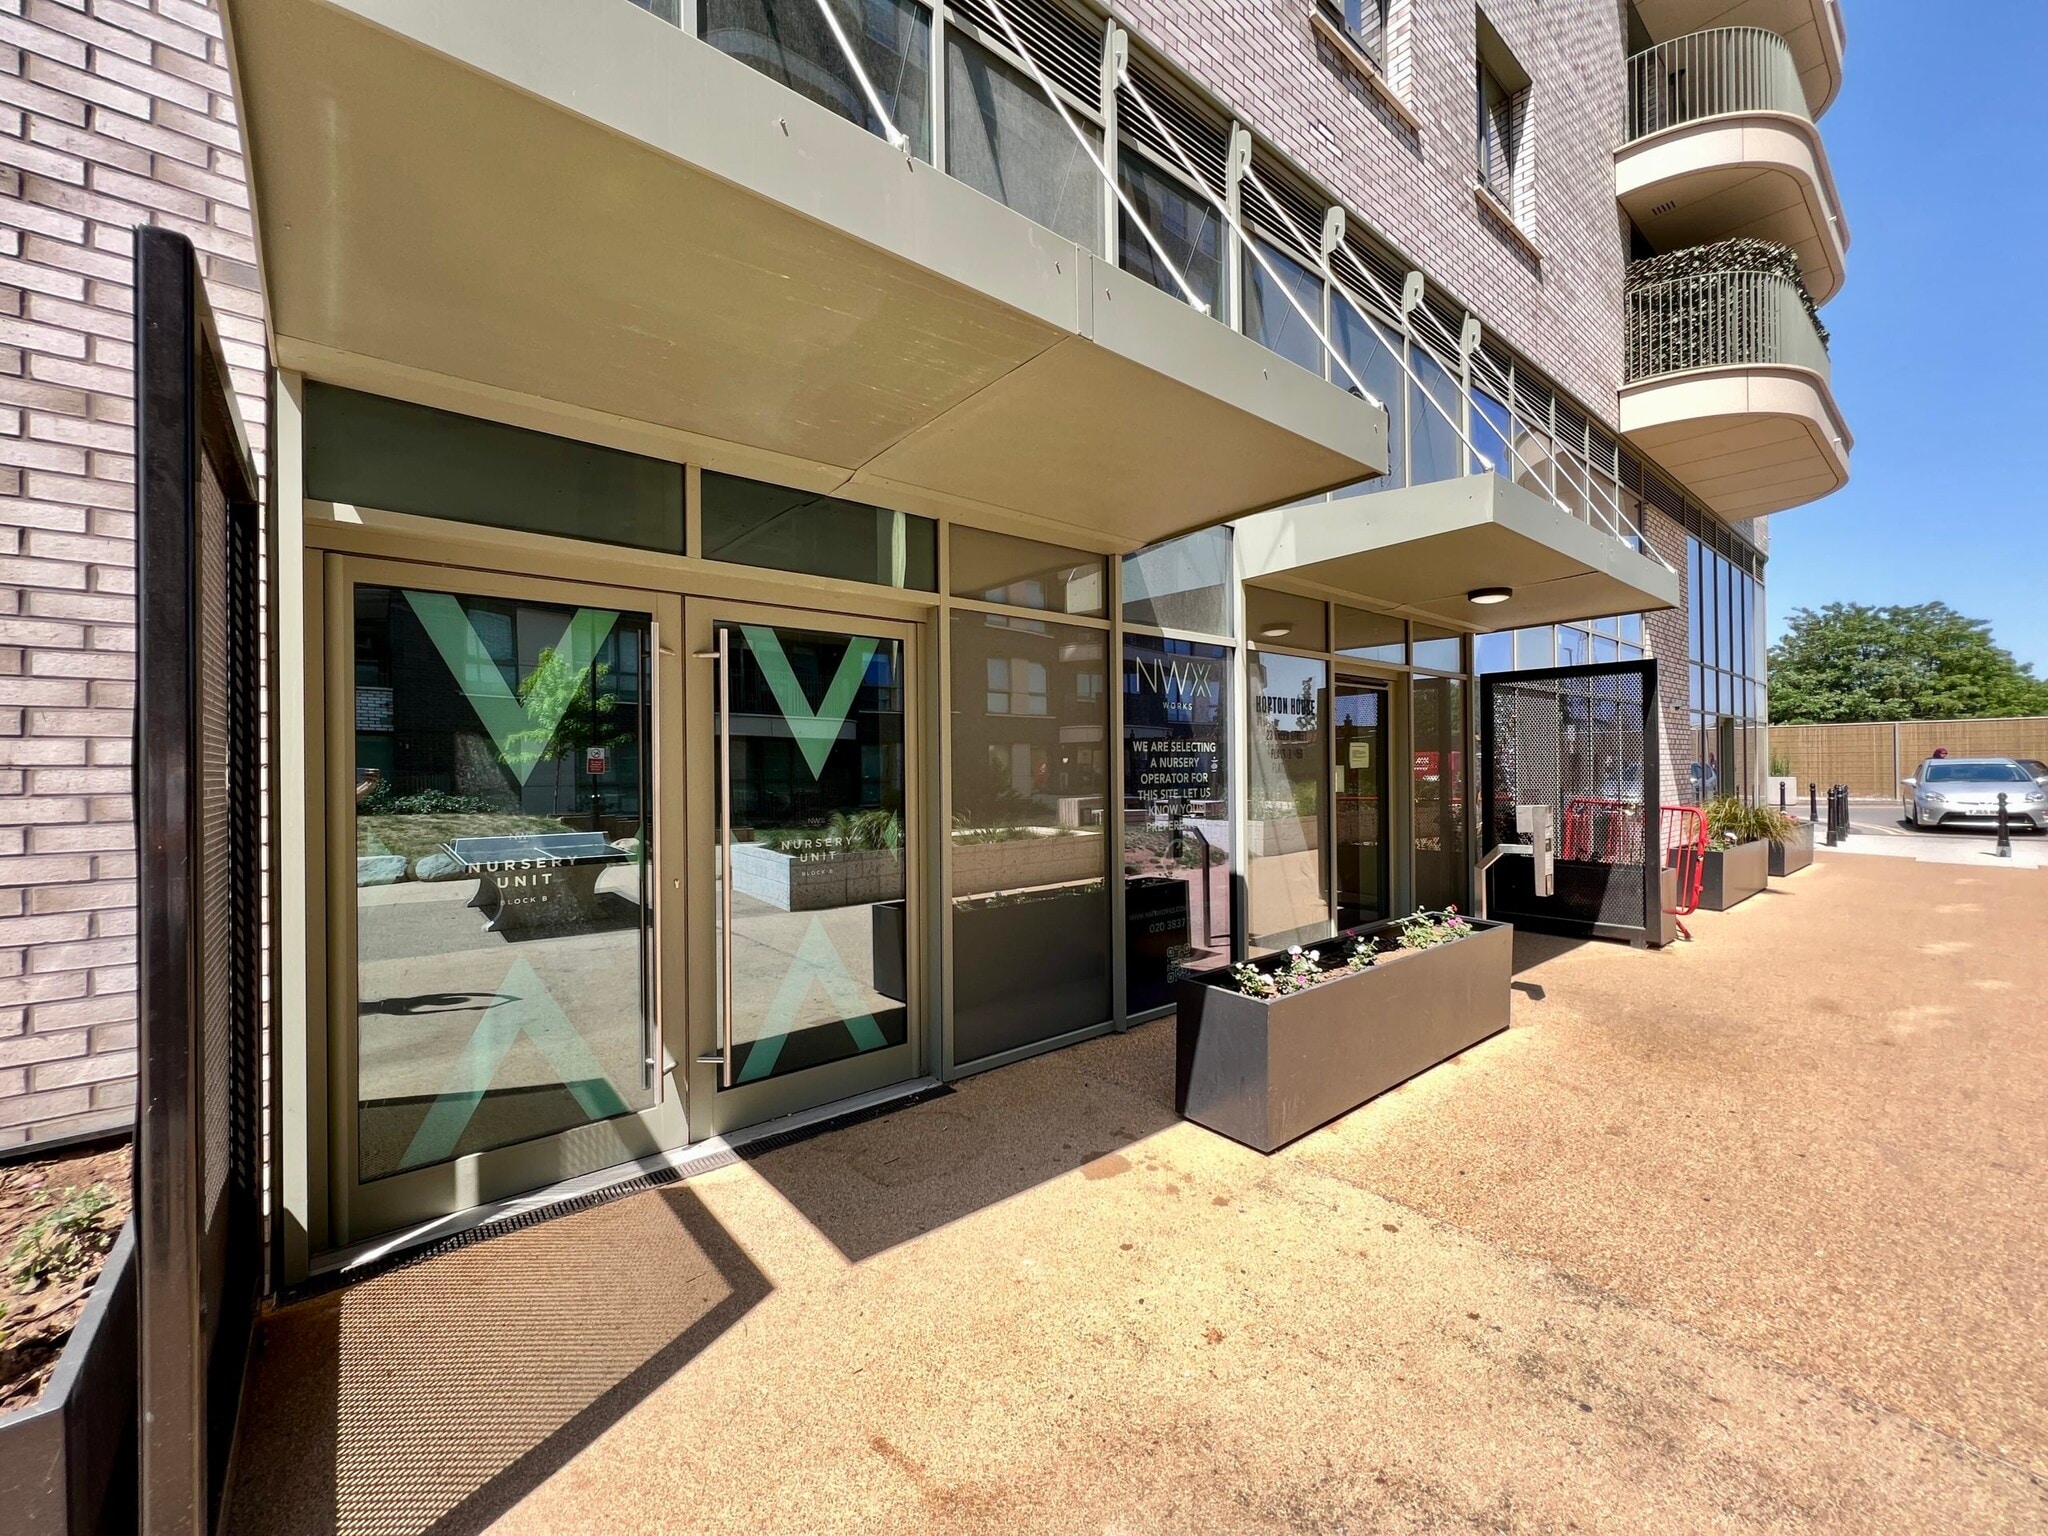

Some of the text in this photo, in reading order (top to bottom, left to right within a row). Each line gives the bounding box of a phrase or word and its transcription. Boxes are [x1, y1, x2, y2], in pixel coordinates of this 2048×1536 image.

[1136, 656, 1212, 698] NWX
[1162, 701, 1193, 711] WORKS
[1290, 698, 1316, 716] HOUSE
[1132, 740, 1217, 753] WE ARE SELECTING
[1150, 757, 1200, 769] A NURSERY
[1140, 772, 1209, 785] OPERATOR FOR
[1137, 789, 1159, 801] THIS
[1183, 788, 1199, 799] LET
[1200, 787, 1212, 798] US
[1148, 803, 1206, 817] KNOW YOUR
[781, 836, 853, 851] NURSERY
[800, 851, 836, 863] UNIT
[468, 855, 578, 874] NURSERY
[801, 868, 826, 877] BLOCK
[496, 873, 552, 889] UNIT
[500, 897, 537, 906] BLOCK
[1149, 921, 1165, 934] 020
